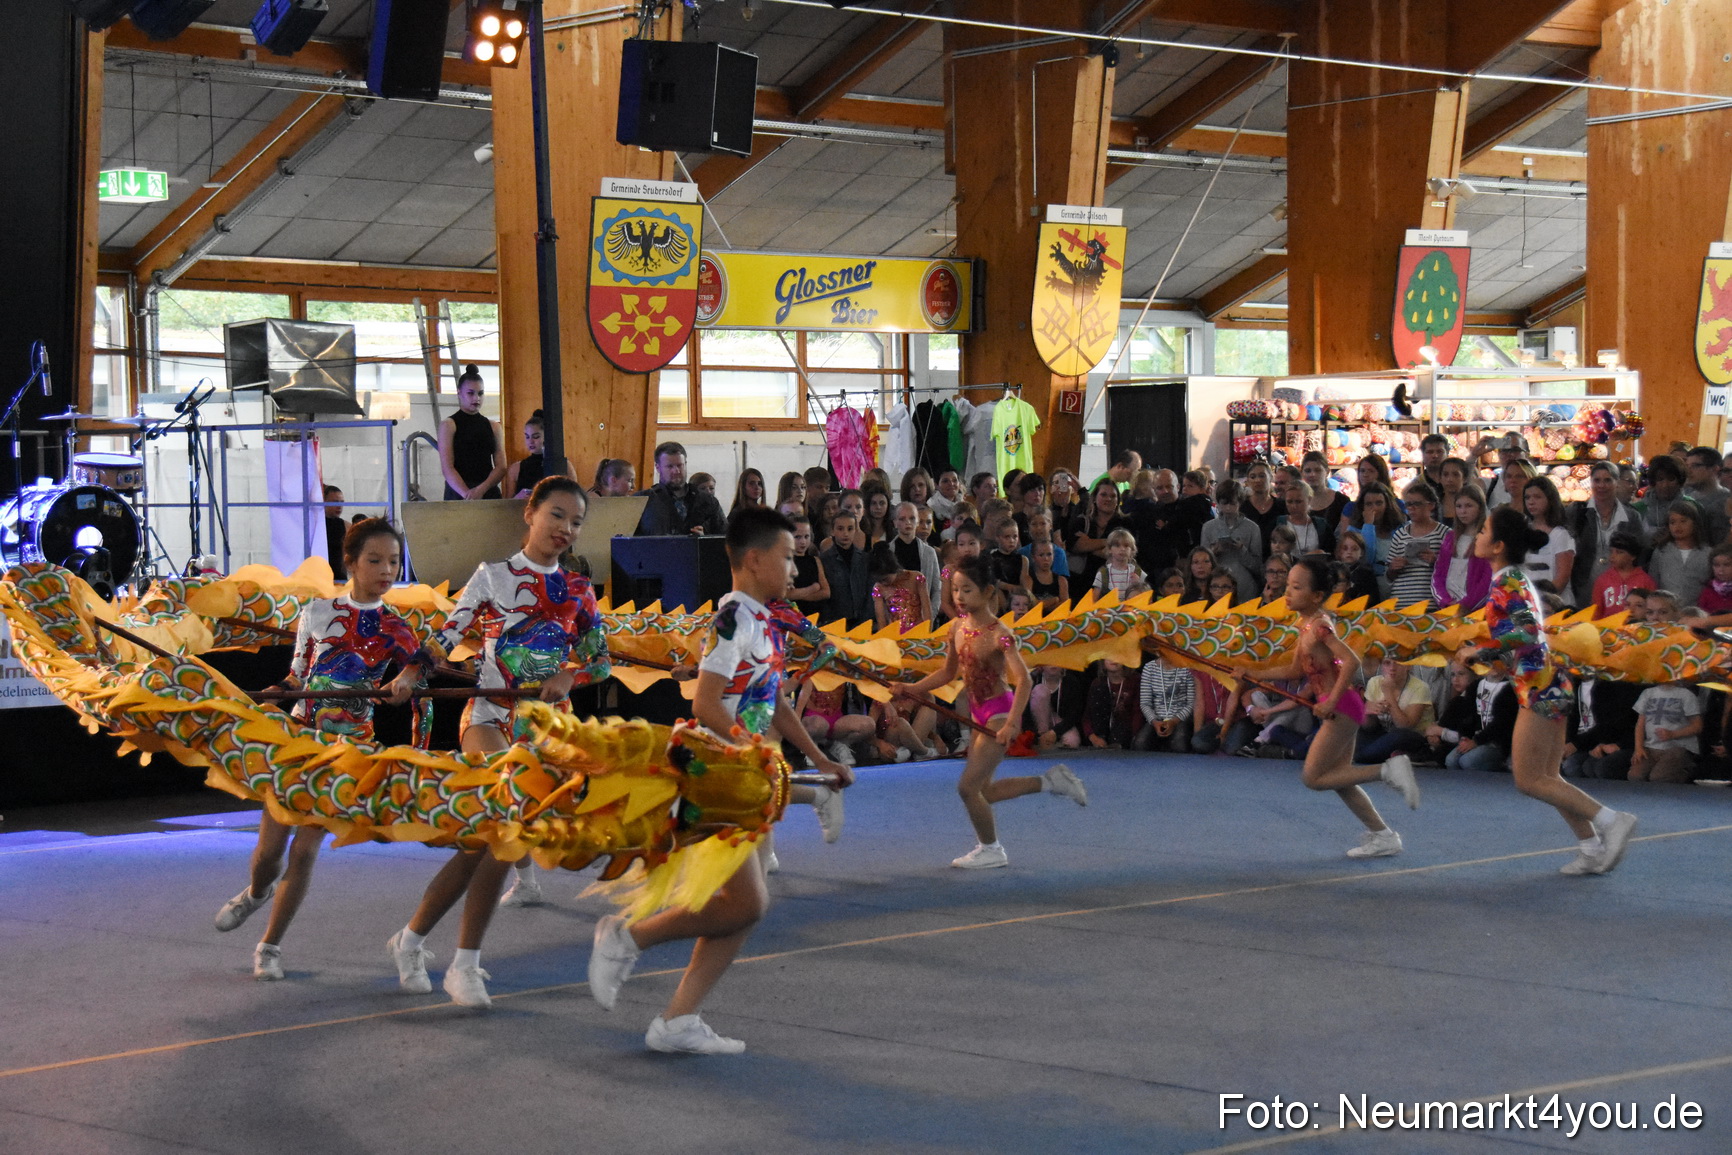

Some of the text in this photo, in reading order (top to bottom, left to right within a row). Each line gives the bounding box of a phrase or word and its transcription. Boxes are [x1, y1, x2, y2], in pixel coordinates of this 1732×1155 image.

[611, 182, 684, 198] Gemeinde Seubersdorf
[1060, 209, 1086, 220] Gemeinde
[775, 260, 878, 326] Glossner
[831, 296, 879, 325] Bier
[1710, 394, 1726, 407] WC
